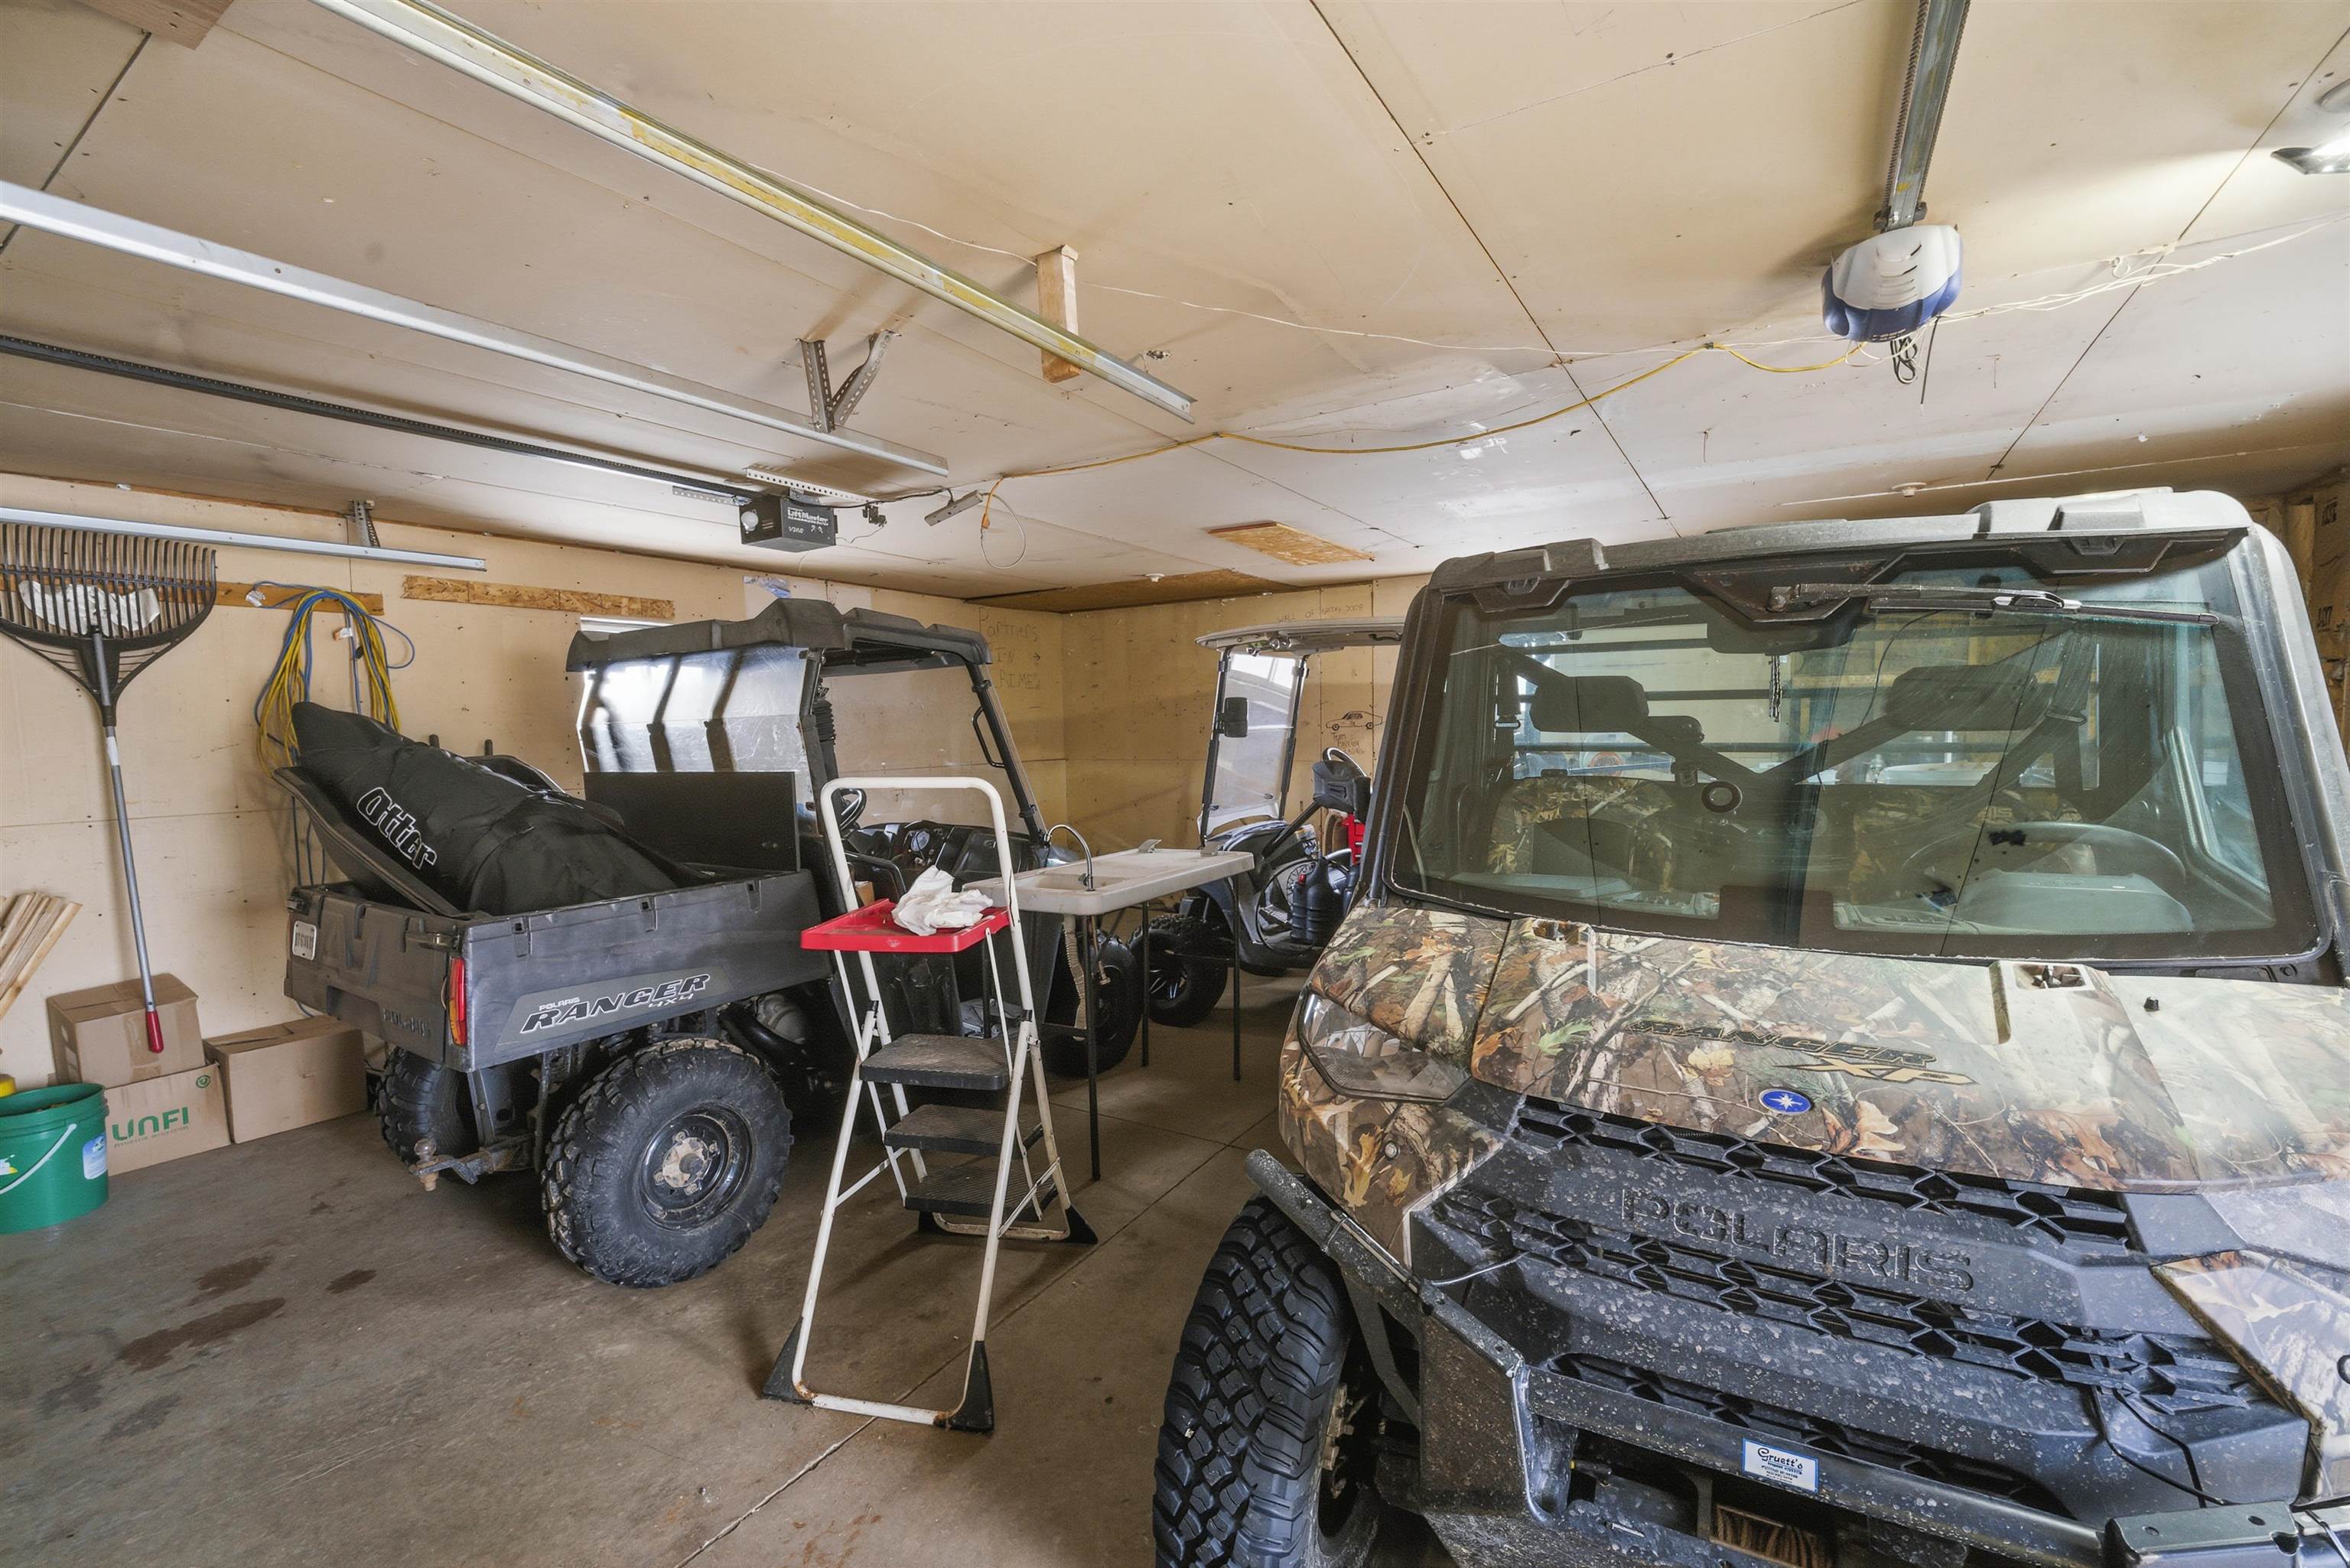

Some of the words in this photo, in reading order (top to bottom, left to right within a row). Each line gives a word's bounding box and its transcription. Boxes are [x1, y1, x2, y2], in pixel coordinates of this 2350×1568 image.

[787, 509, 829, 524] LiftMaster
[356, 786, 438, 870] Otter
[519, 973, 711, 1034] RANGER
[539, 996, 581, 1012] POLARIS
[1624, 1020, 1938, 1069] RANGER
[1773, 1052, 1981, 1085] XP
[1621, 1188, 1974, 1293] POLARIS
